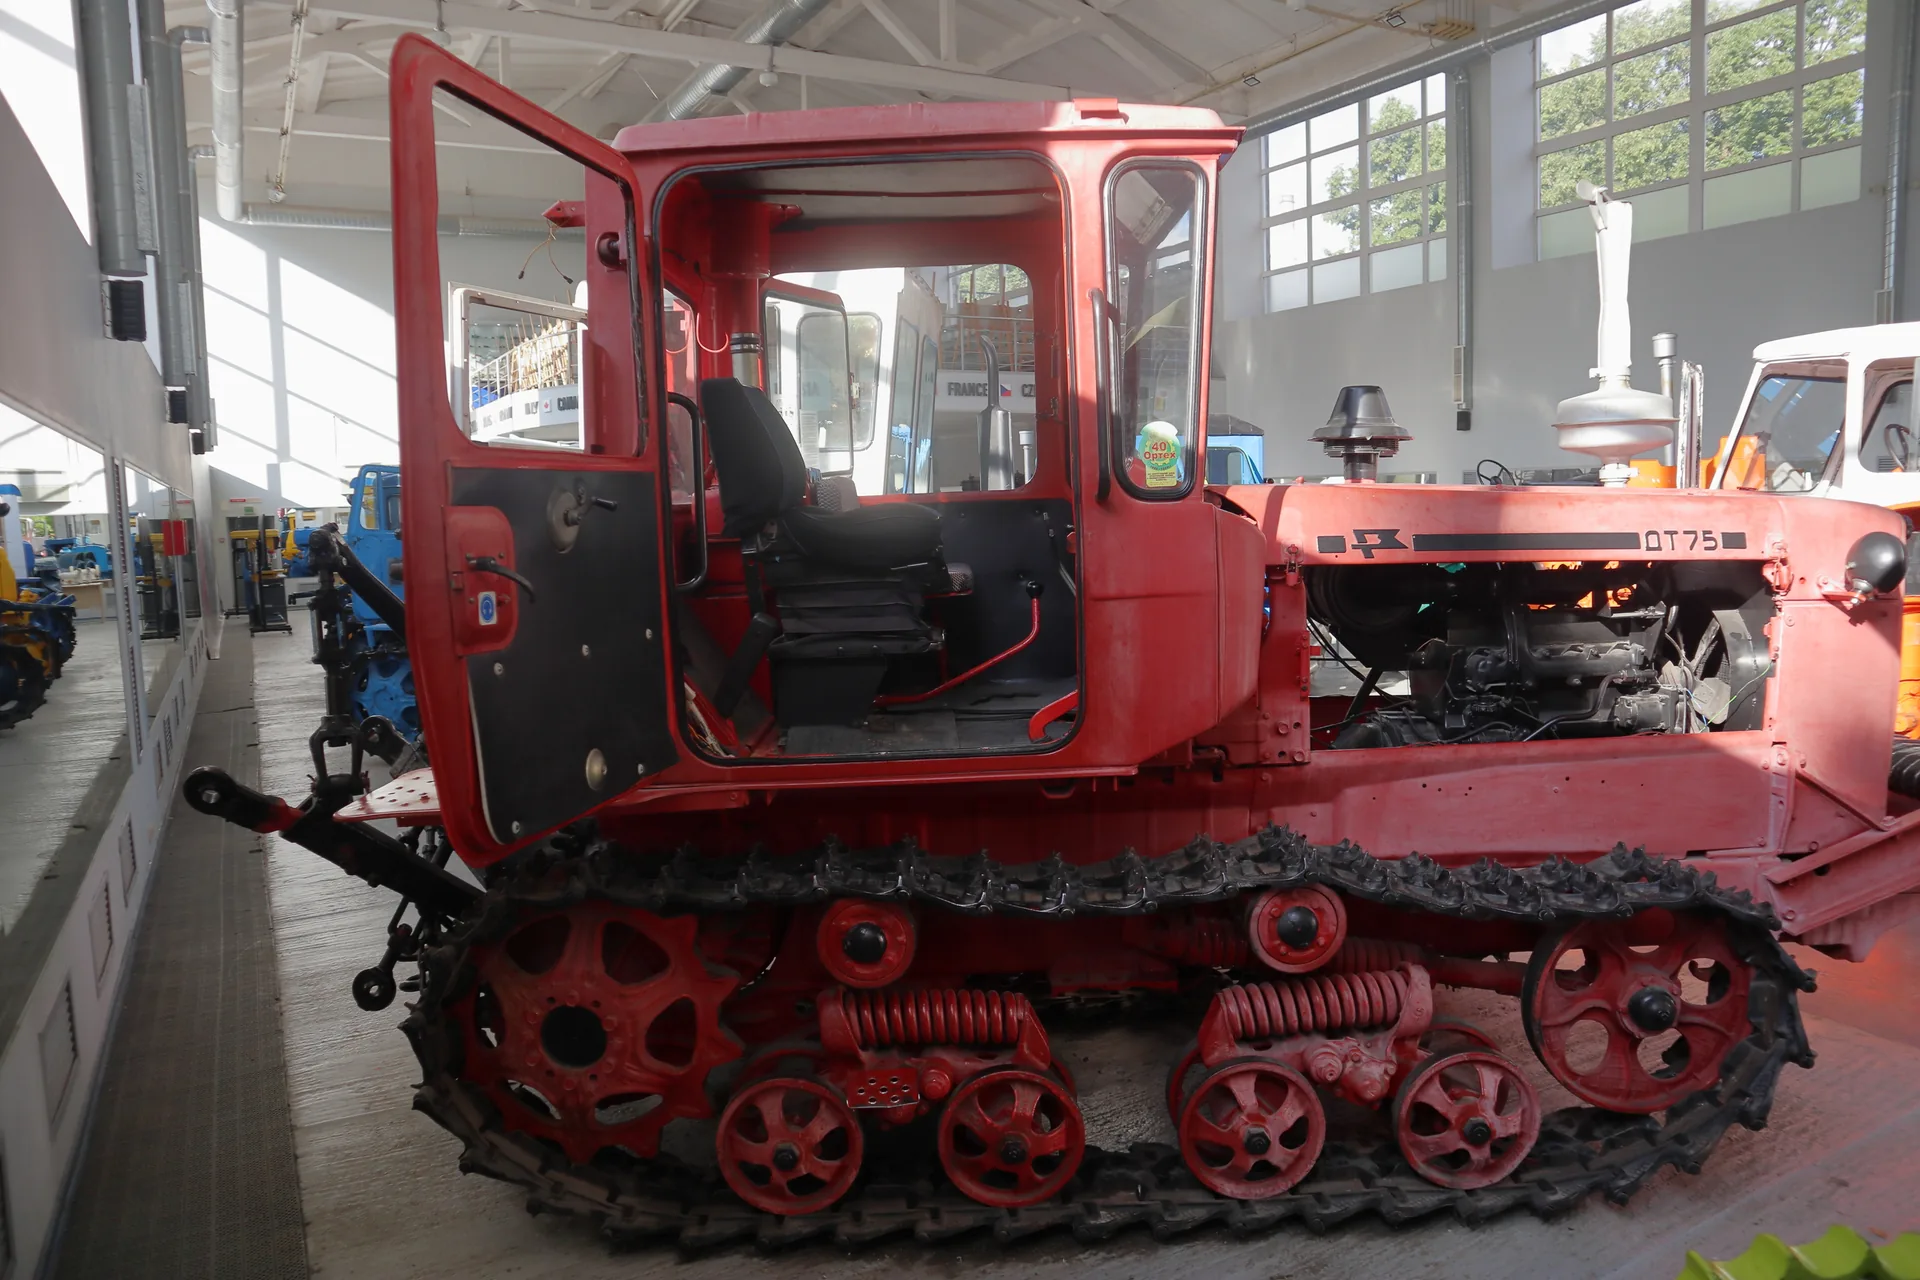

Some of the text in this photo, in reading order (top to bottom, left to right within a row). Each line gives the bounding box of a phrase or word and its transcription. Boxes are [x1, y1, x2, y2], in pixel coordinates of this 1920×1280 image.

[947, 382, 988, 397] FRANCE
[1151, 441, 1167, 451] 40
[1143, 451, 1176, 461] Ортех
